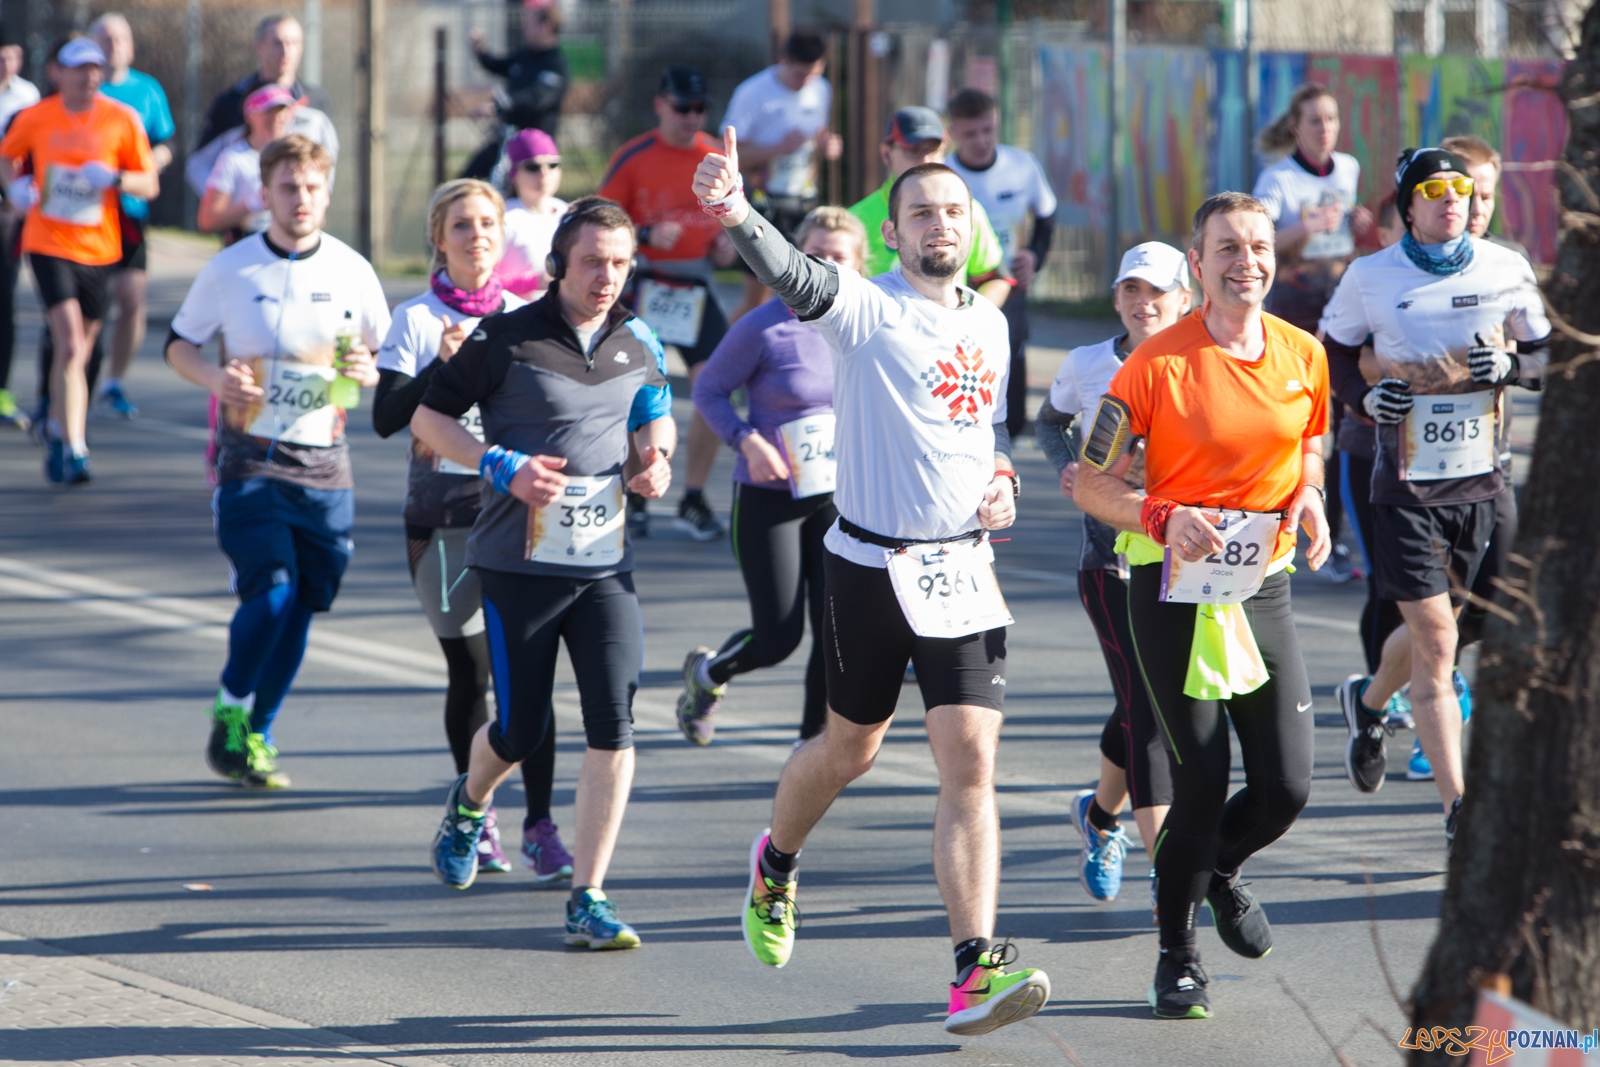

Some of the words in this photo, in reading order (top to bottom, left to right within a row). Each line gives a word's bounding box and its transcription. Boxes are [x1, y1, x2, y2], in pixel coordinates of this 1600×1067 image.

[268, 385, 326, 409] 2406
[1424, 418, 1479, 443] 8613
[560, 504, 607, 527] 338
[1210, 568, 1235, 577] Jacek
[917, 570, 979, 600] 9361
